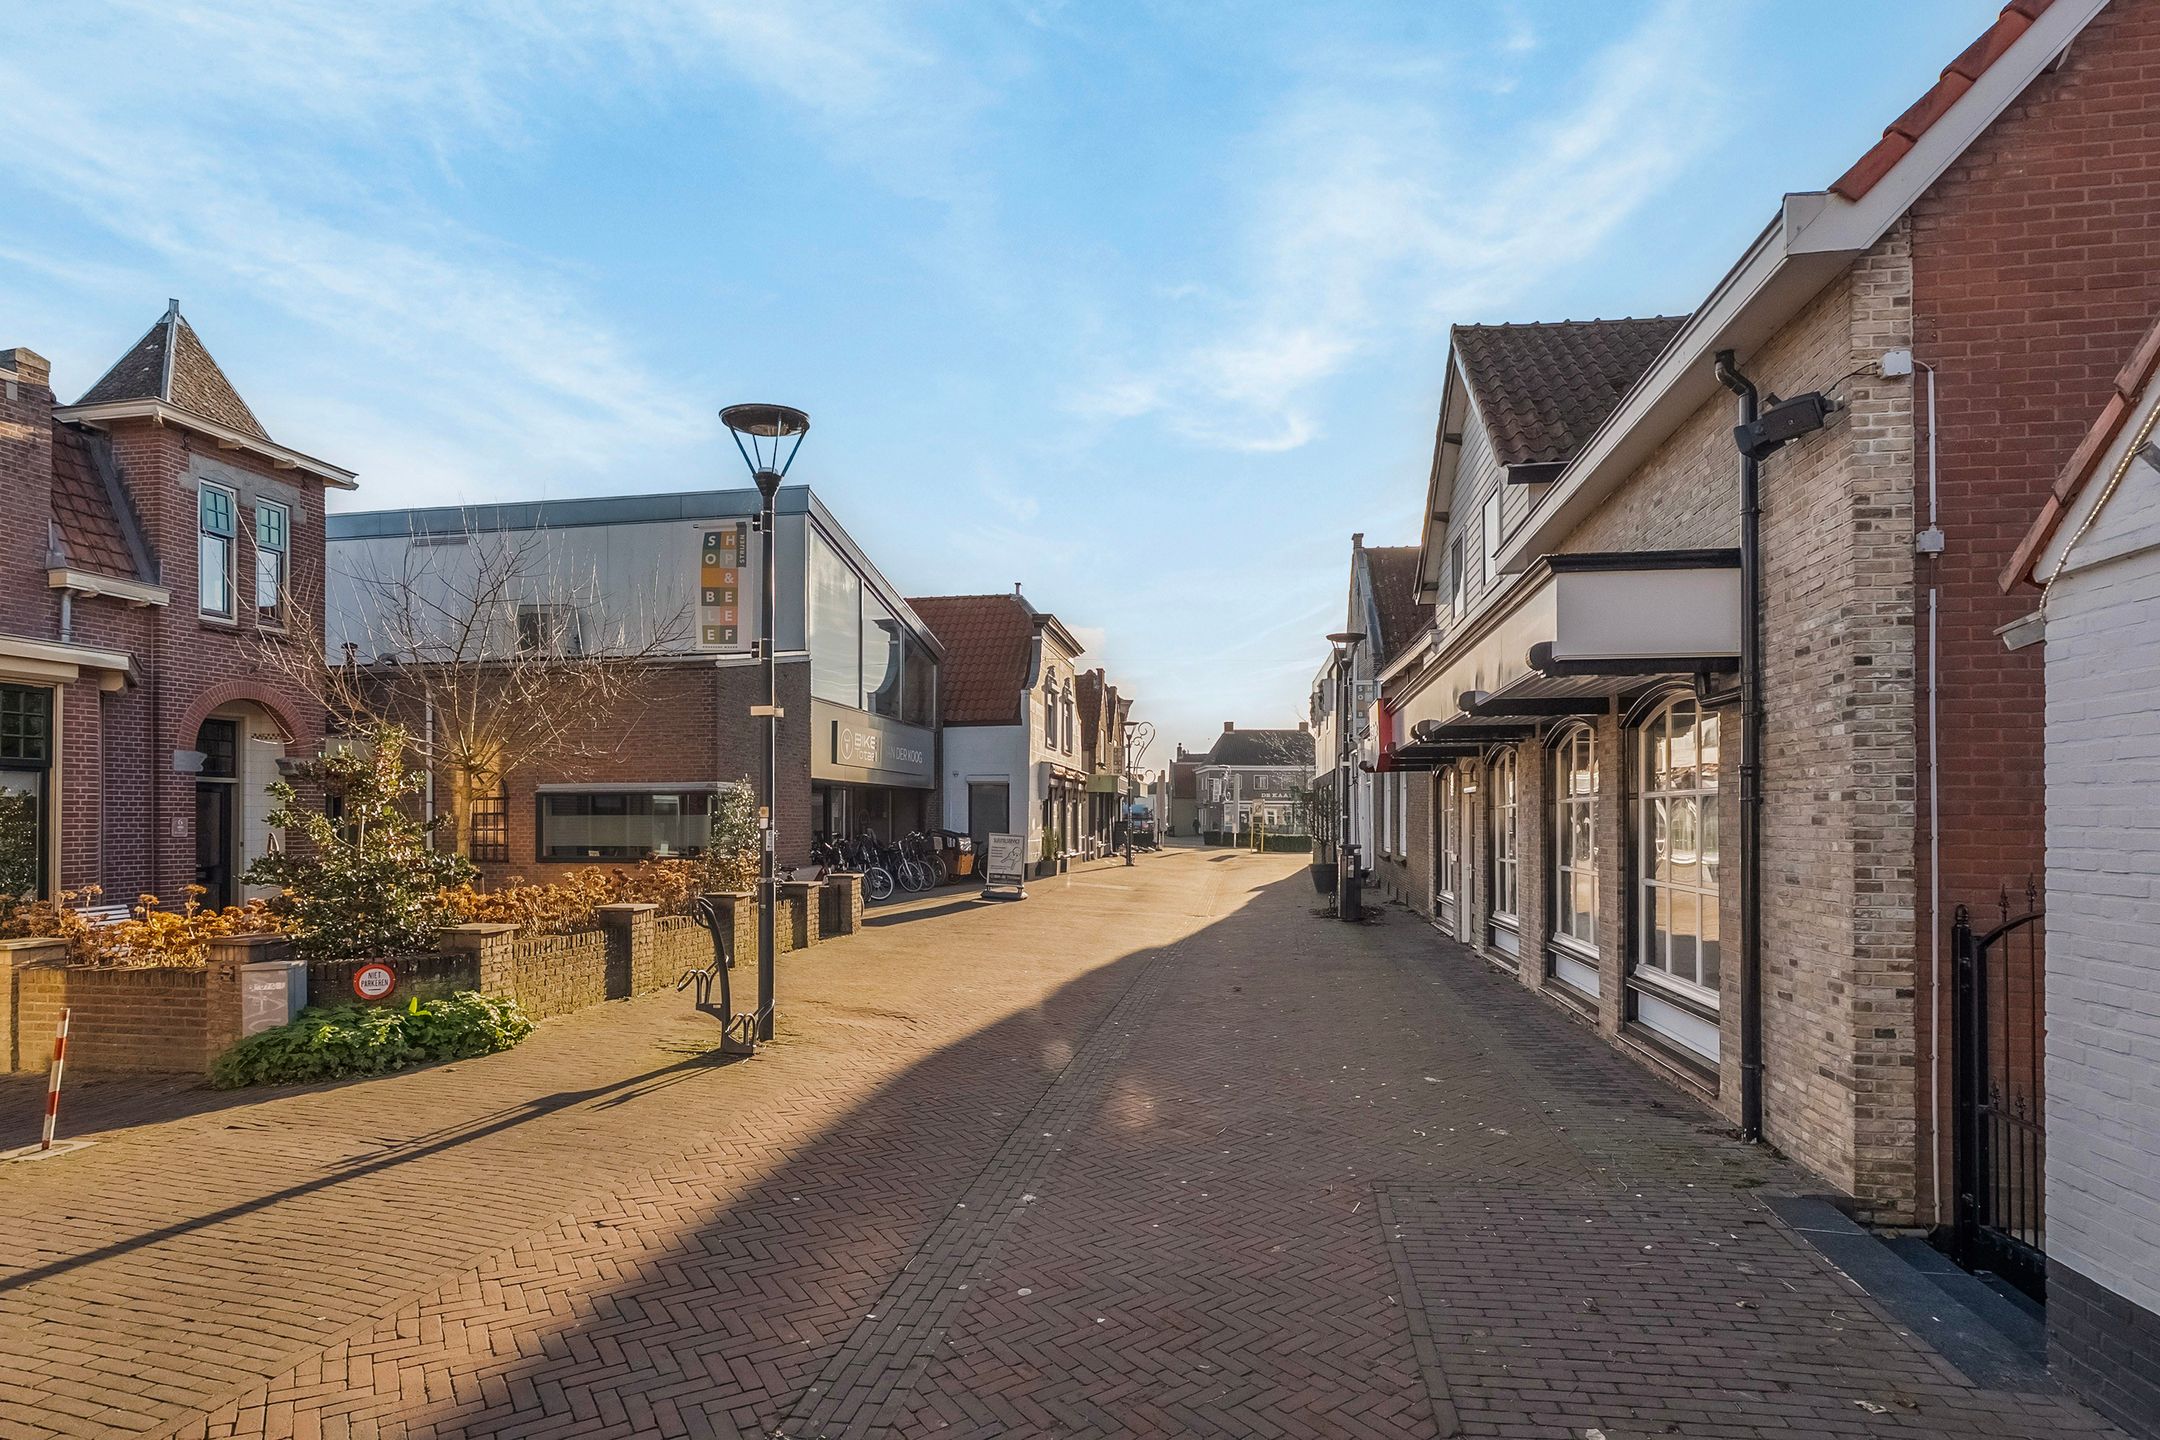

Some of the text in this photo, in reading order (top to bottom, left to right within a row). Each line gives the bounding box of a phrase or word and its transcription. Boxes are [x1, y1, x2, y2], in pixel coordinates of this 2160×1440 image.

[854, 732, 876, 750] BIKE
[896, 747, 908, 761] DER
[907, 750, 923, 764] KOOG
[367, 971, 382, 979] NIET
[360, 979, 389, 987] PARKEREN
